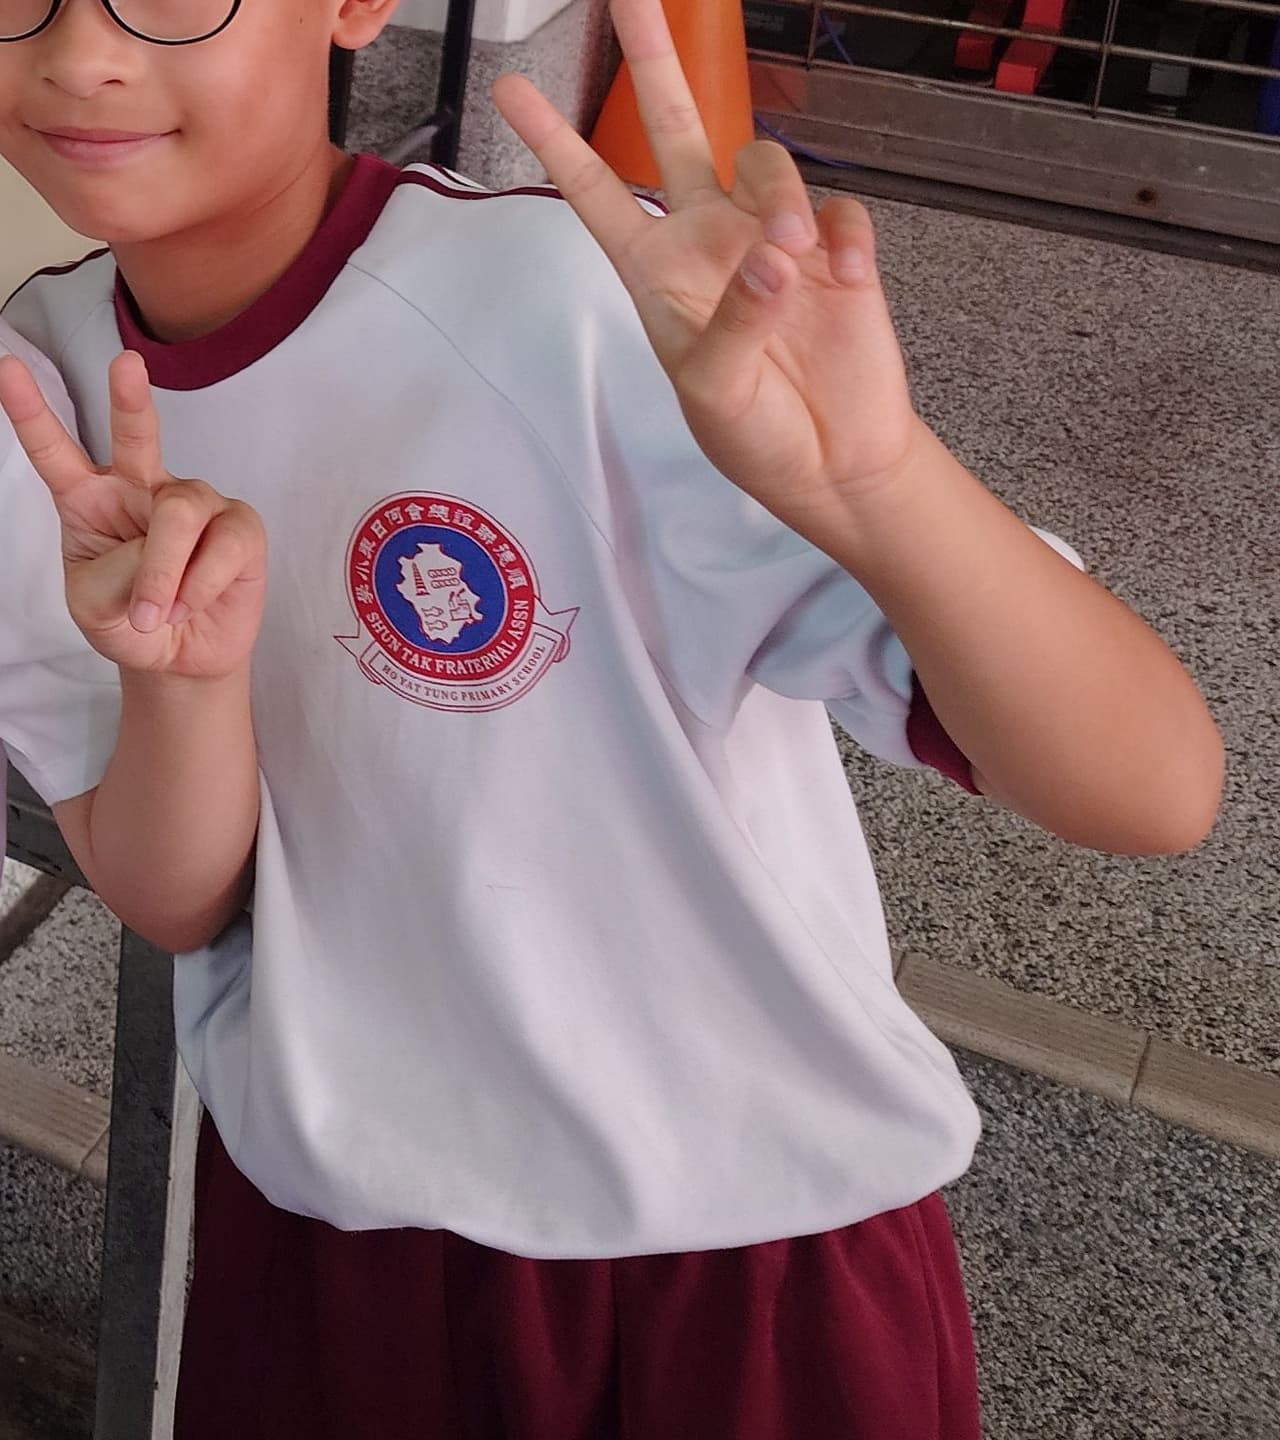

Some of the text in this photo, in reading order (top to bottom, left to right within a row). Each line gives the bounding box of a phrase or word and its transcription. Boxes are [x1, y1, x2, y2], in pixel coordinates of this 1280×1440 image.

[367, 599, 529, 676] SHUN TAK FRATERNAL ASSN
[382, 645, 546, 702] HO YAT TUNG PRIMARY SCHOOL
